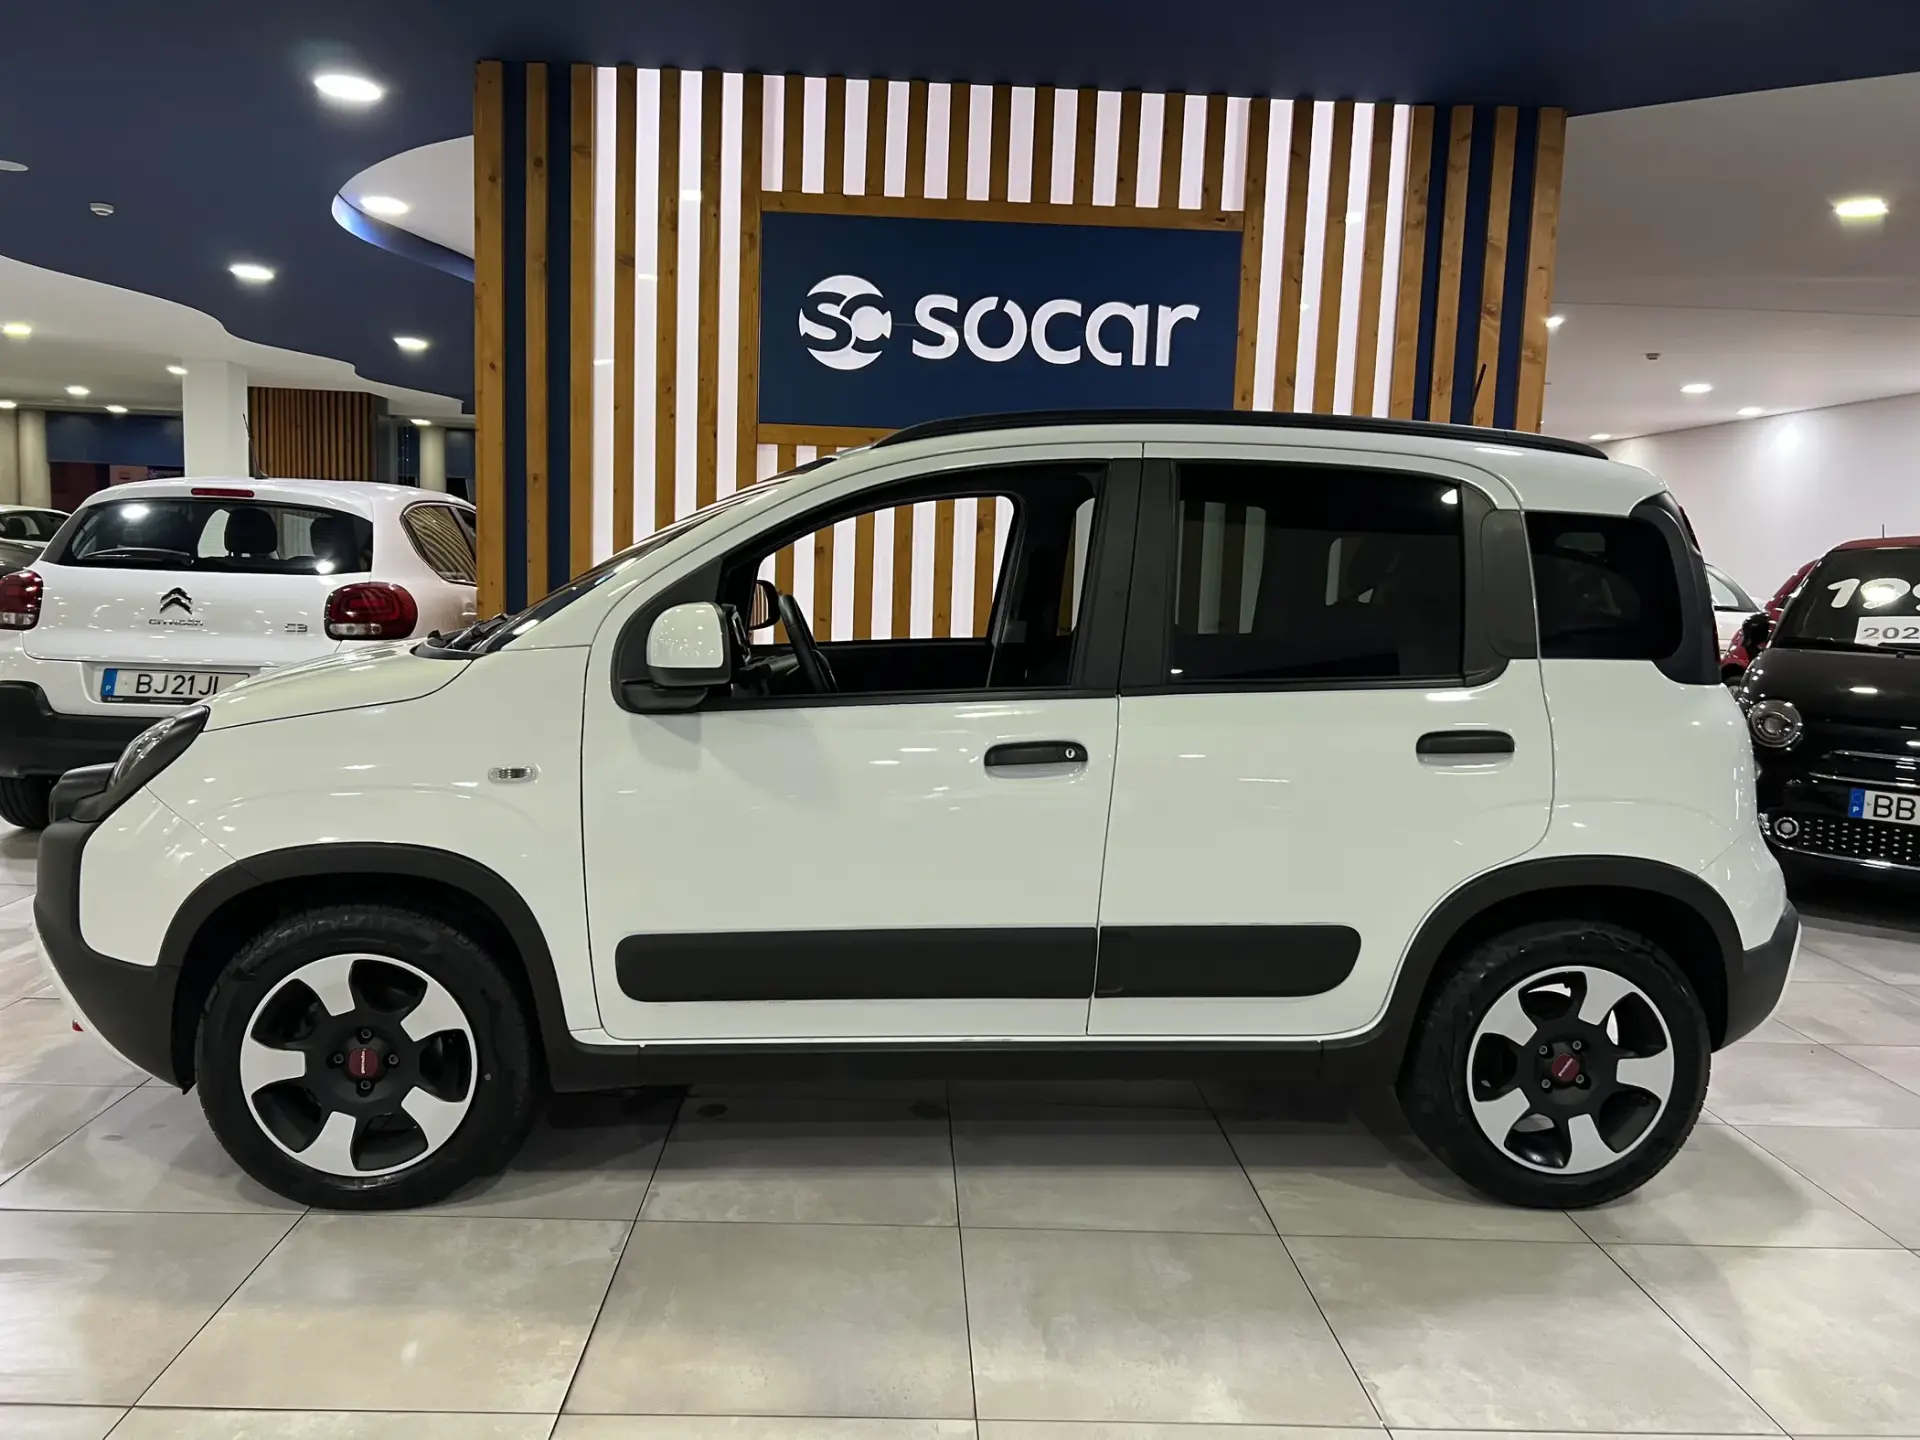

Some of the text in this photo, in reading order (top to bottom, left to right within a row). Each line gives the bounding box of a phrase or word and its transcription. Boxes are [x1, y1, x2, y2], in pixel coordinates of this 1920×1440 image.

[912, 294, 1200, 367] socar
[284, 622, 308, 633] C3
[1872, 794, 1916, 821] BB
